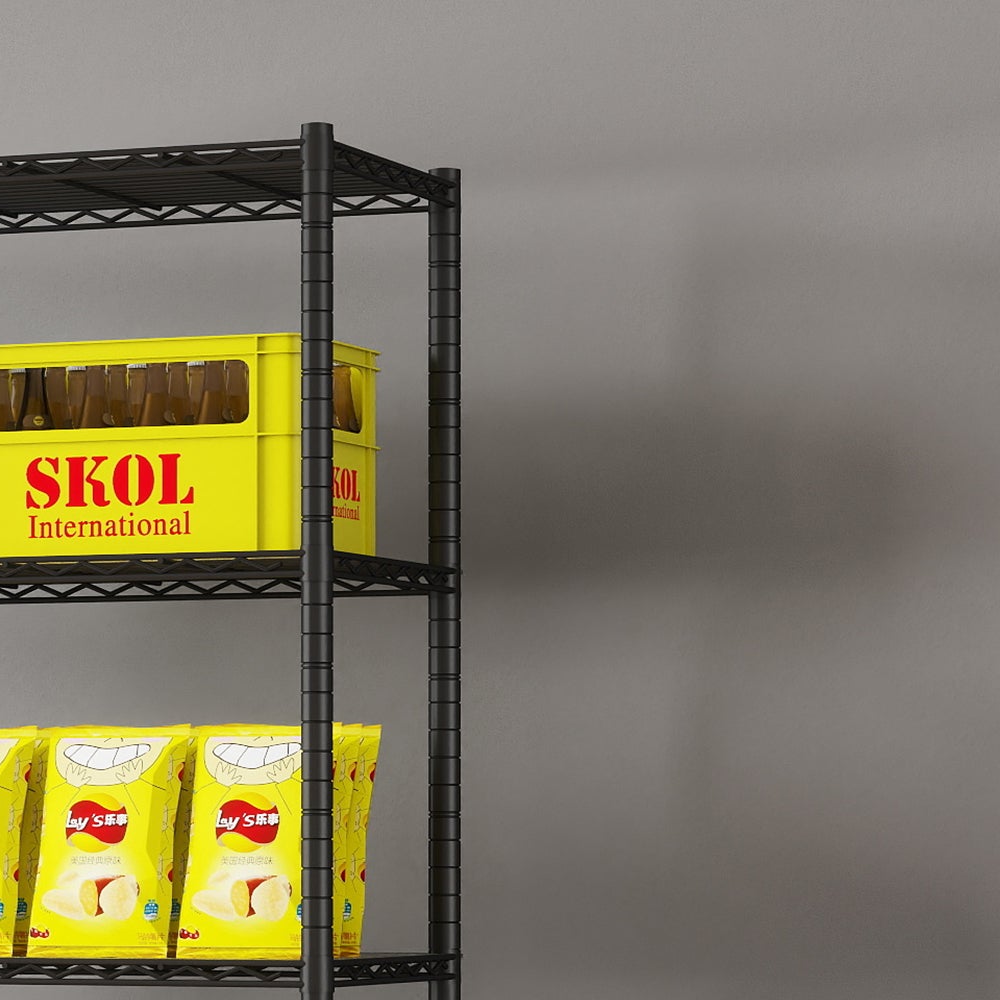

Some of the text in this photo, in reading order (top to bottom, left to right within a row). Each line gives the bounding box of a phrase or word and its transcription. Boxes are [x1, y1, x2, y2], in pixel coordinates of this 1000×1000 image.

[26, 453, 194, 509] SKOL
[333, 466, 360, 502] KOL
[28, 510, 191, 539] International
